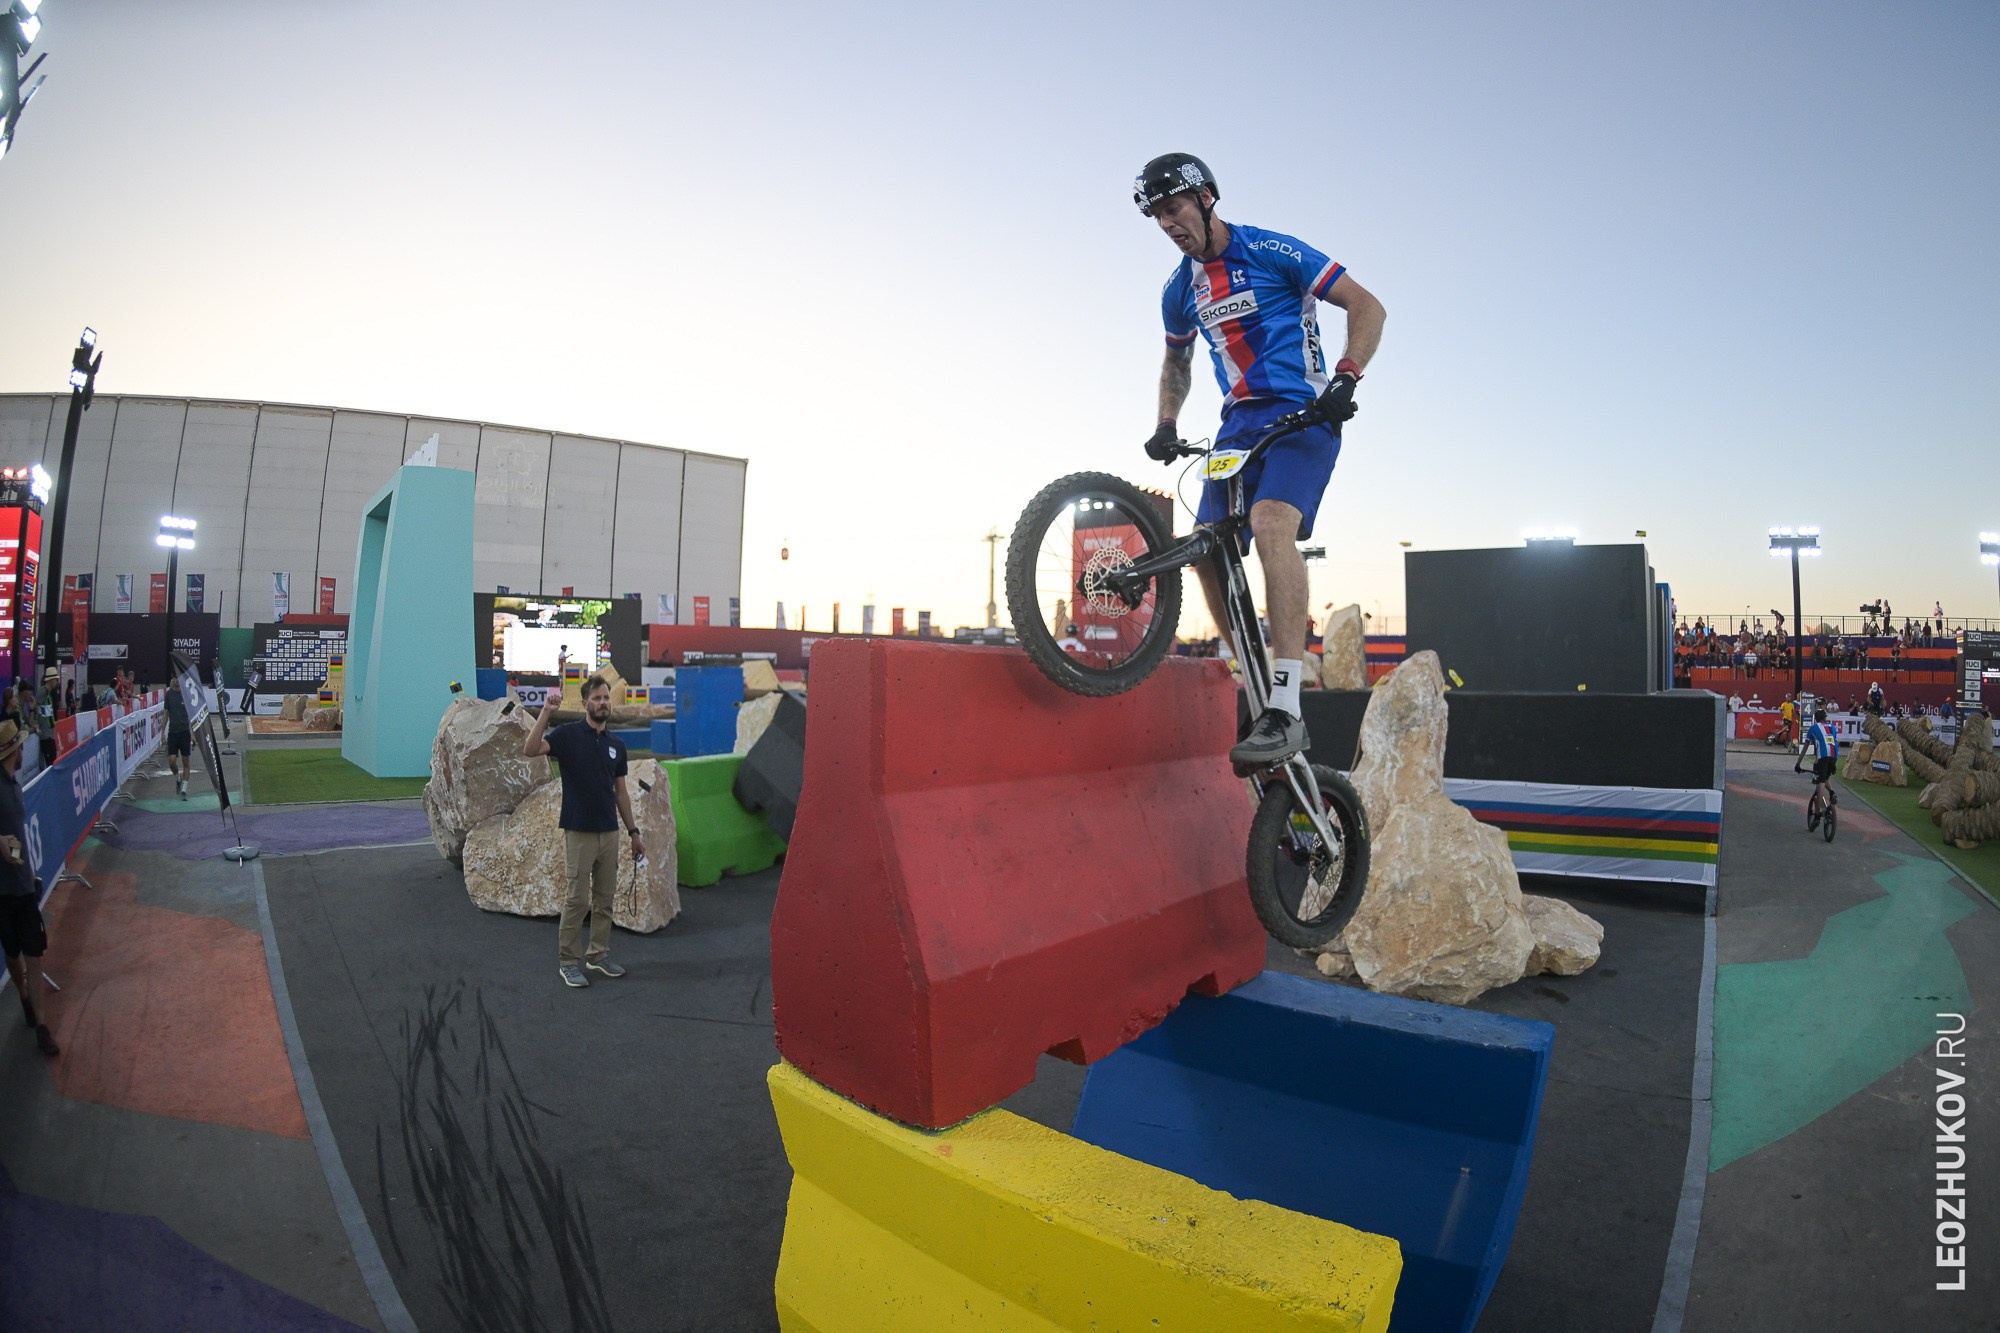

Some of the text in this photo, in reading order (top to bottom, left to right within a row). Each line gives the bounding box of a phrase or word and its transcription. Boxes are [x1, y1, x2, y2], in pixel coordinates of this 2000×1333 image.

[1211, 459, 1231, 472] 25
[173, 638, 200, 647] RIYADH
[1969, 633, 1981, 641] UCI
[185, 677, 199, 707] 3
[517, 690, 548, 702] SOT
[1804, 703, 1812, 715] 4
